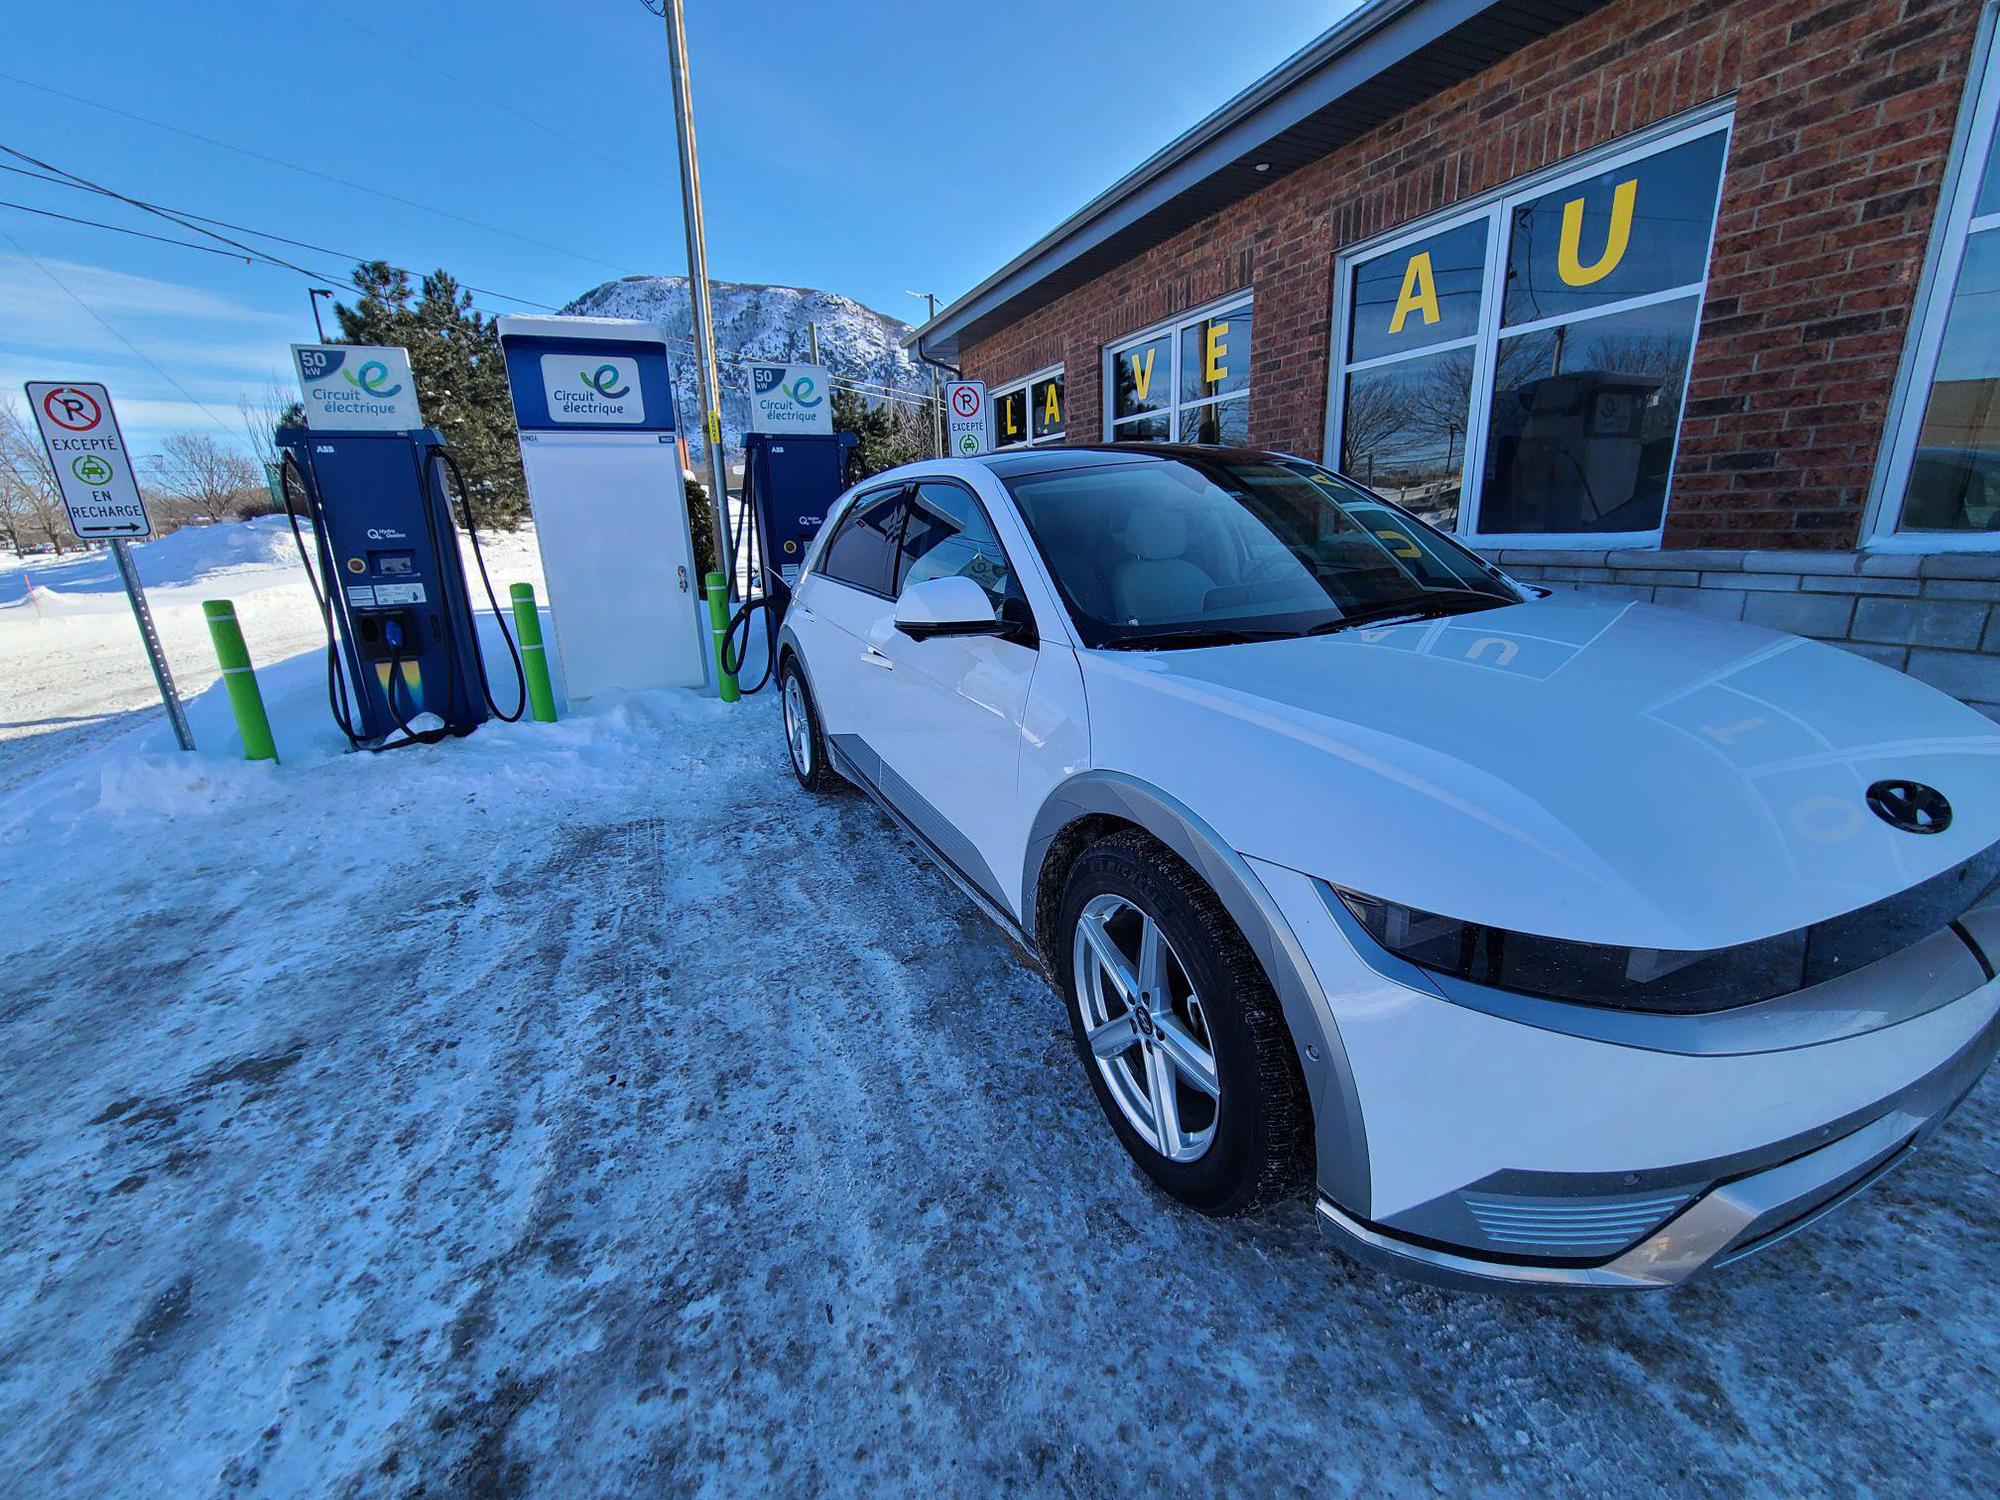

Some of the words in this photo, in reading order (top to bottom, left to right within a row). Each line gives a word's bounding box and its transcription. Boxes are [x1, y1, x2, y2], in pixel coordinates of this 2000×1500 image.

[301, 351, 327, 367] 50
[304, 367, 321, 376] kW
[755, 370, 773, 383] 50
[756, 382, 768, 390] kW
[312, 388, 360, 400] Circuit
[553, 389, 595, 402] Circuit
[324, 401, 396, 416] électrique
[563, 402, 624, 416] électrique
[760, 400, 793, 410] Circuit
[767, 411, 817, 422] électrique
[952, 419, 984, 432] EXCEPTÉ
[52, 436, 118, 451] EXCEPTÉ
[316, 445, 335, 453] ABB
[92, 491, 112, 502] EN
[71, 504, 143, 518] RECHARGE
